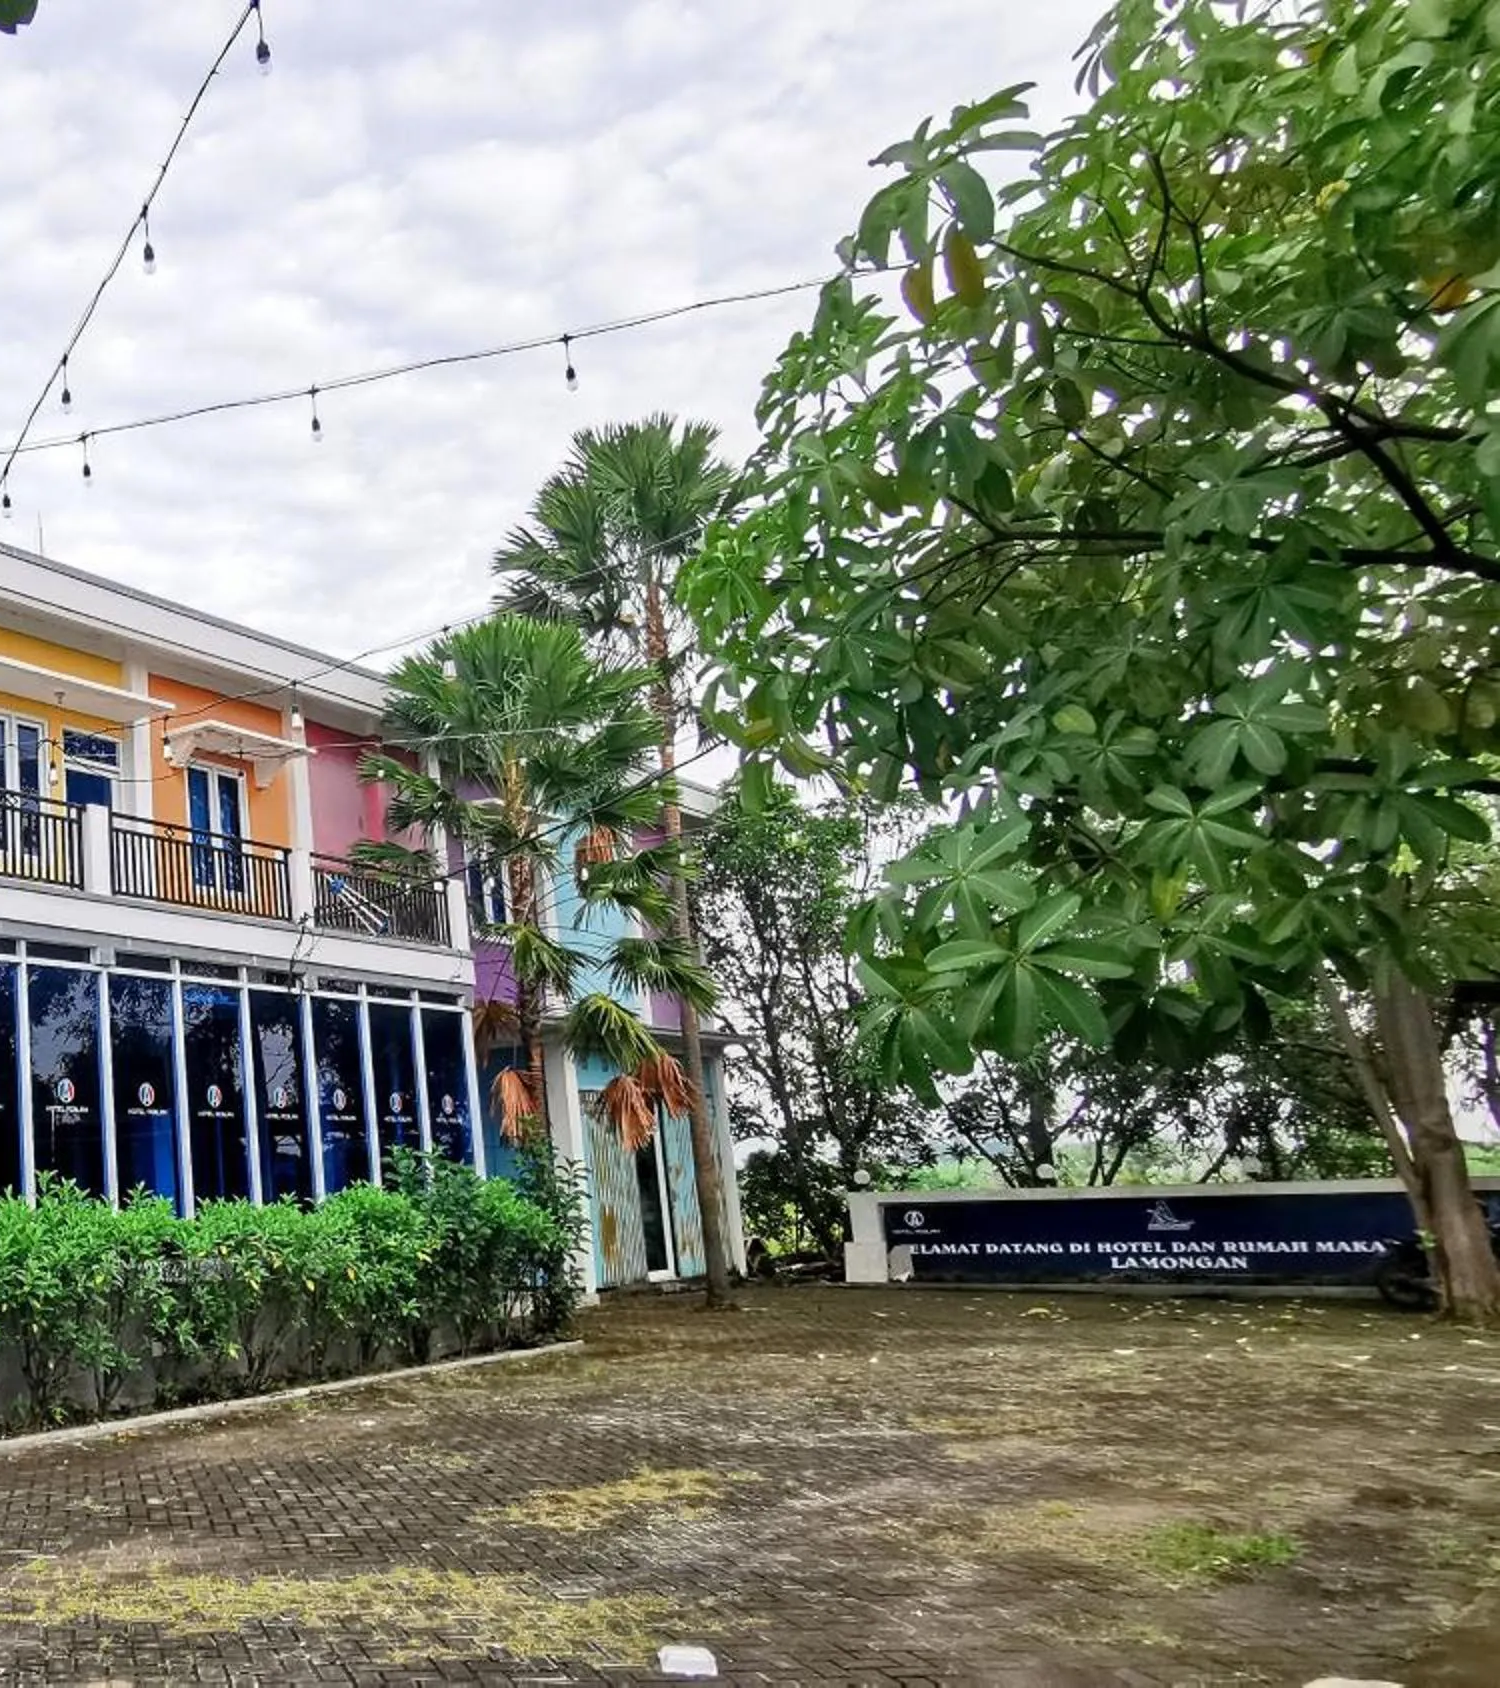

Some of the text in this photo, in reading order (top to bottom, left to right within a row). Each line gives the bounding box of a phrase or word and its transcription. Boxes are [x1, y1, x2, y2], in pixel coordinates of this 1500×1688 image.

[909, 1243, 981, 1255] ELAMAT
[985, 1242, 1063, 1254] DATANG
[1069, 1242, 1090, 1253] DI
[1097, 1241, 1166, 1253] HOTEL
[1172, 1241, 1215, 1253] DAN
[1222, 1241, 1309, 1252] RUMAH
[1111, 1256, 1248, 1269] LAMONGAN
